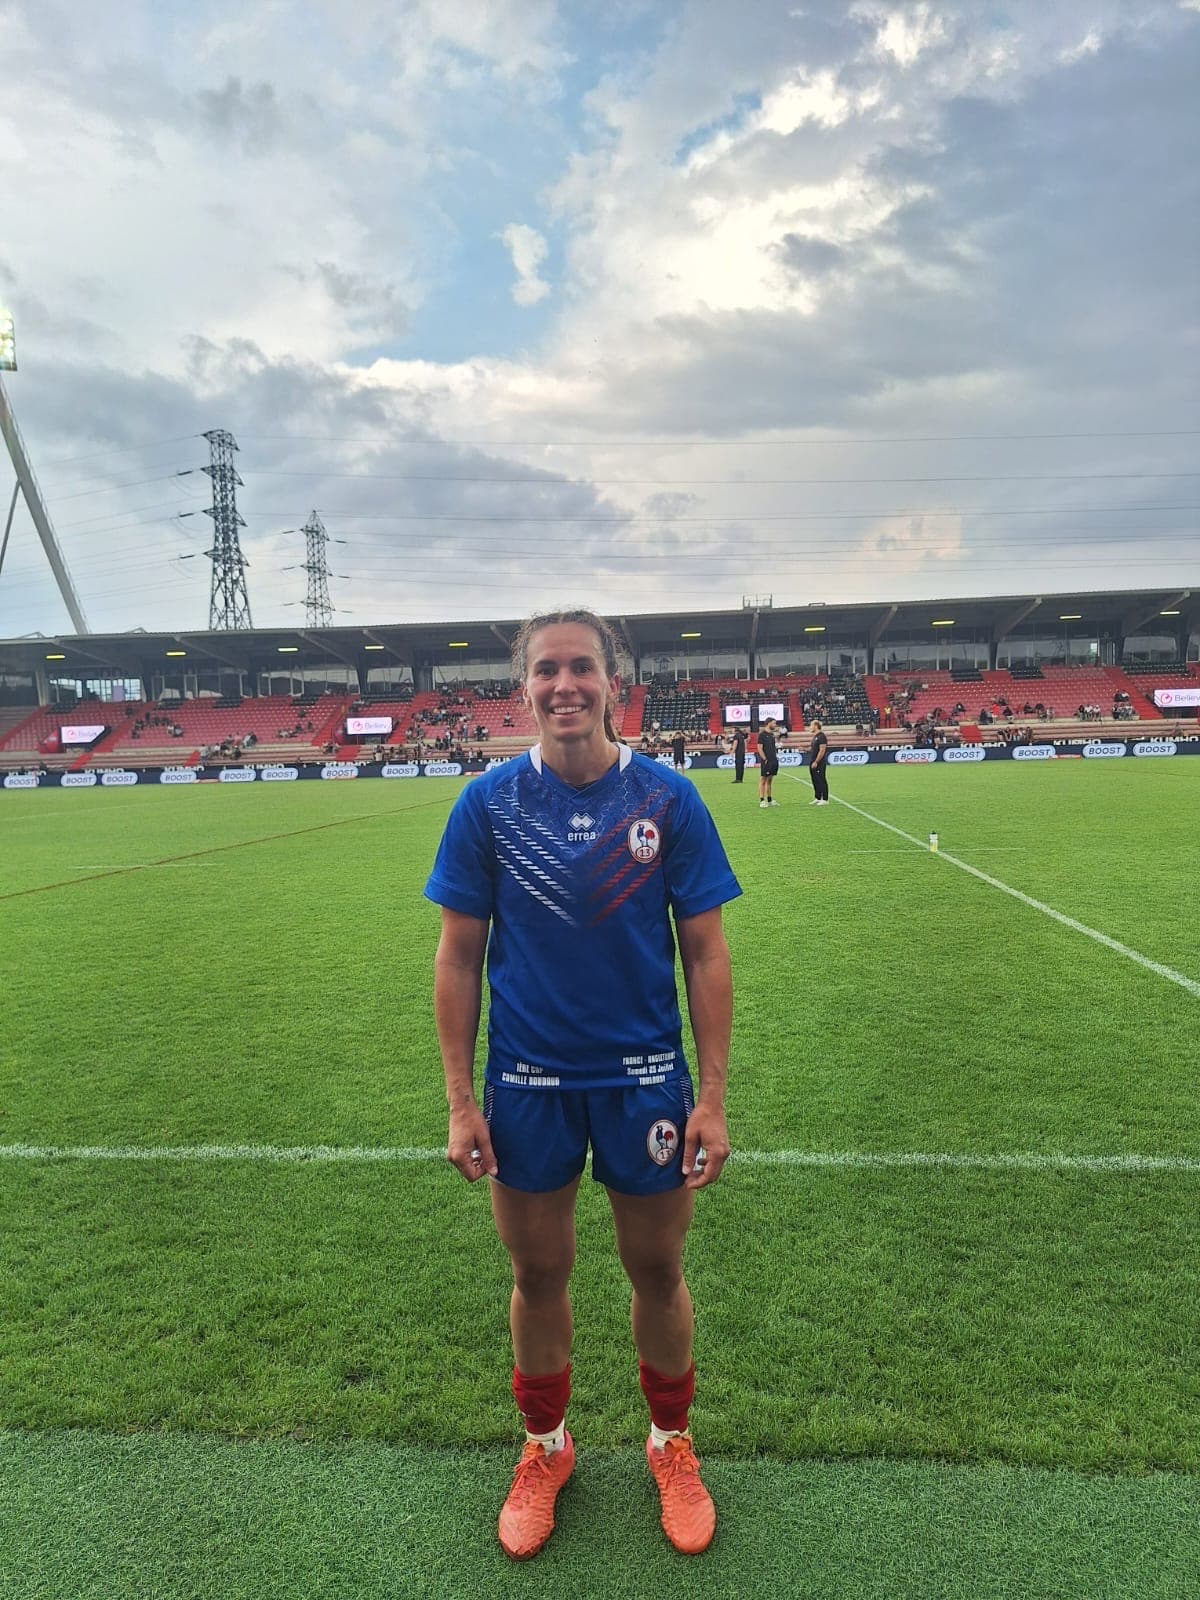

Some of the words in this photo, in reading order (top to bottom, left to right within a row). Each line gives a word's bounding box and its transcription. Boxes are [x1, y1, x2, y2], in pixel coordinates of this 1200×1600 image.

[1018, 748, 1050, 757] BOOST
[1088, 746, 1121, 755] BOOST
[1139, 745, 1172, 753] BOOST
[833, 754, 864, 762] BOOST
[900, 752, 932, 760] BOOST
[948, 751, 981, 759] BOOST
[326, 769, 354, 777] BOOST
[386, 767, 415, 775] BOOST
[429, 766, 458, 774] BOOST
[106, 775, 134, 783] BOOST
[224, 772, 251, 780] BOOST
[8, 778, 37, 786] BOOST
[66, 776, 93, 785] BOOST
[567, 831, 596, 841] errea
[640, 848, 651, 857] 13
[501, 1071, 528, 1085] CAMILLE
